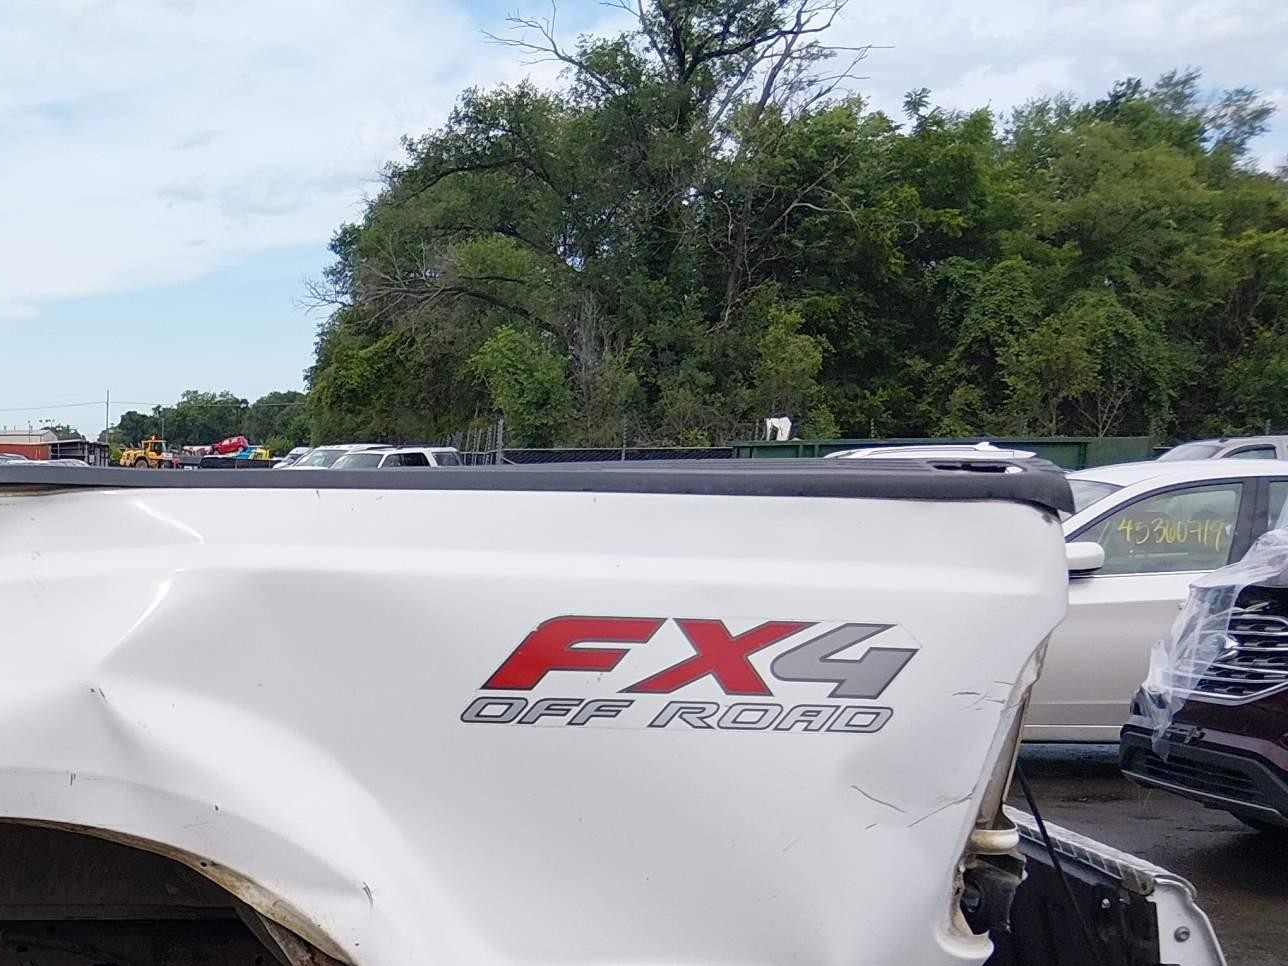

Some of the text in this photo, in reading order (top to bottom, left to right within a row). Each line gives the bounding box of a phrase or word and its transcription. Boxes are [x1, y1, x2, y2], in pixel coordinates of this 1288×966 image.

[481, 614, 921, 699] FX4
[460, 696, 895, 734] OFF ROAD
